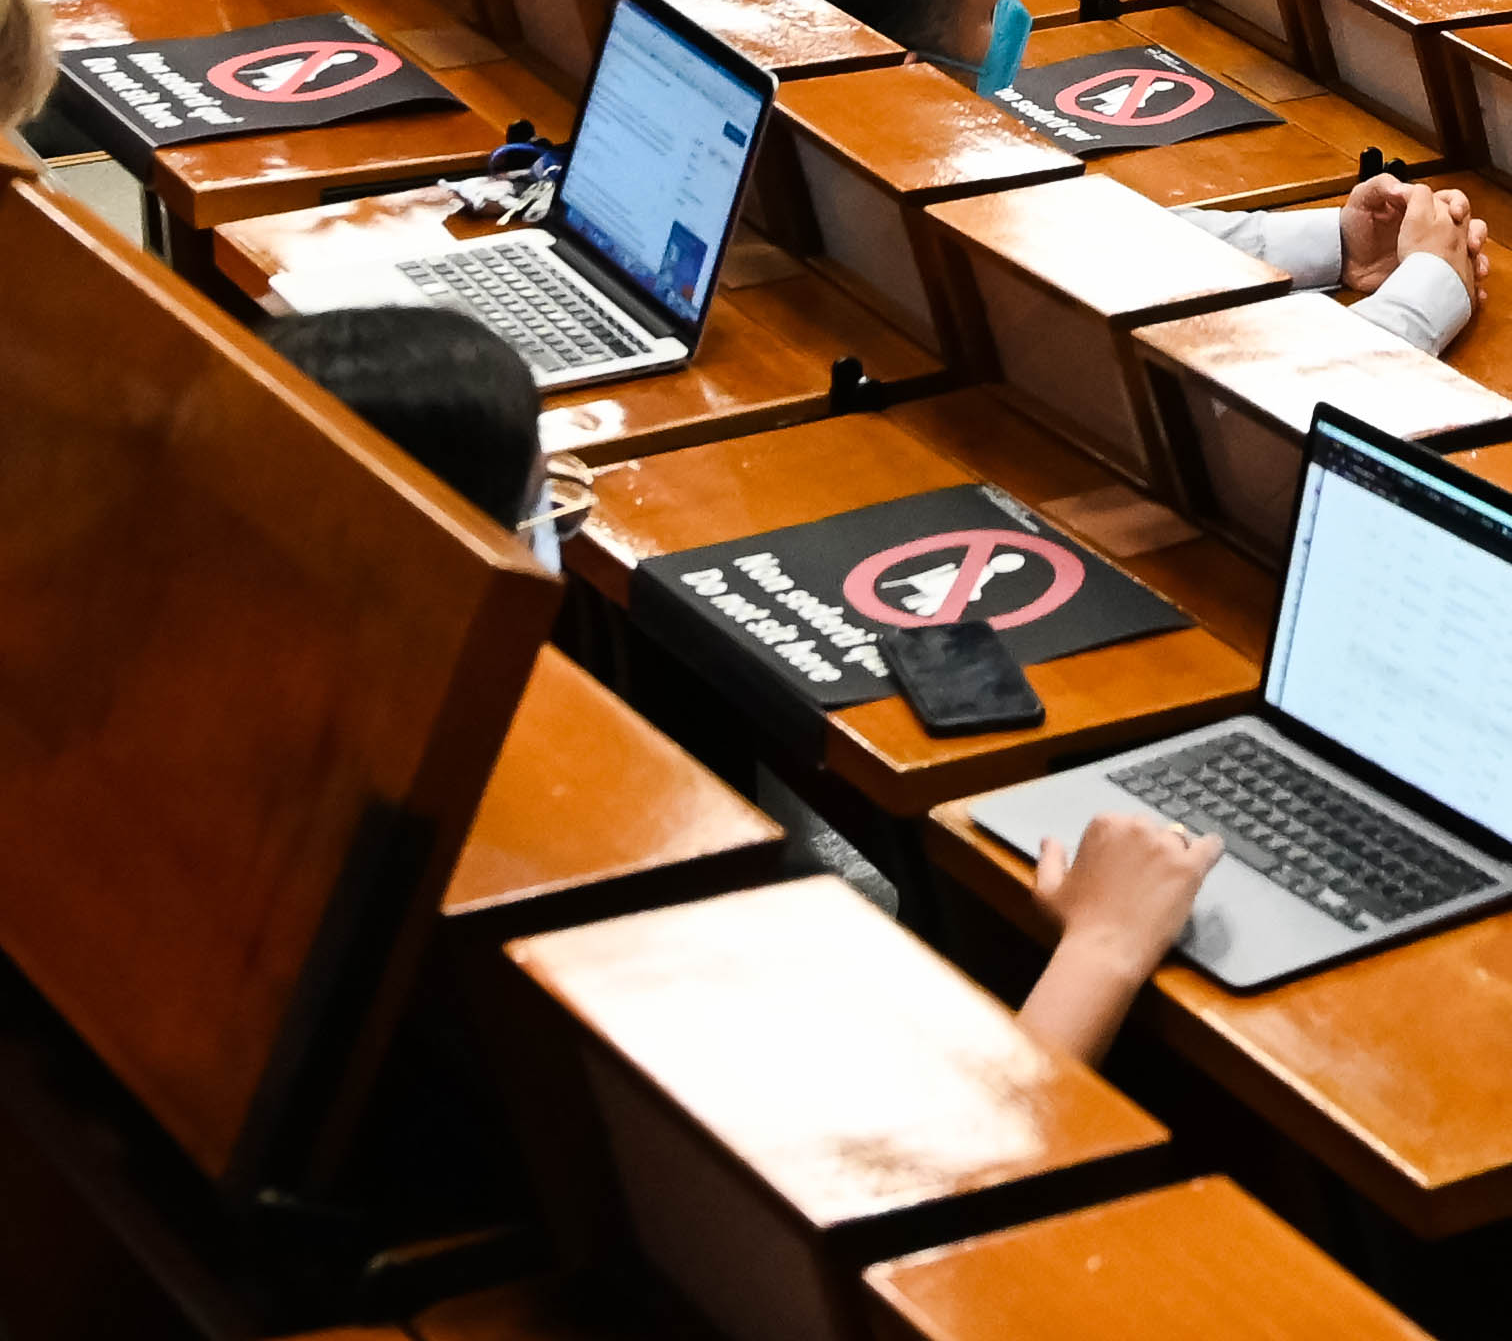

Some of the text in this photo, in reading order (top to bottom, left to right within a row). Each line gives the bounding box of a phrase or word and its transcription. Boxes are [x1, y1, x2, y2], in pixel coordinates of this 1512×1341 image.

[81, 57, 183, 128] Do not sit here
[127, 52, 245, 124] Non sederti qui
[733, 552, 795, 593] Non
[679, 568, 842, 682] Do not sit here
